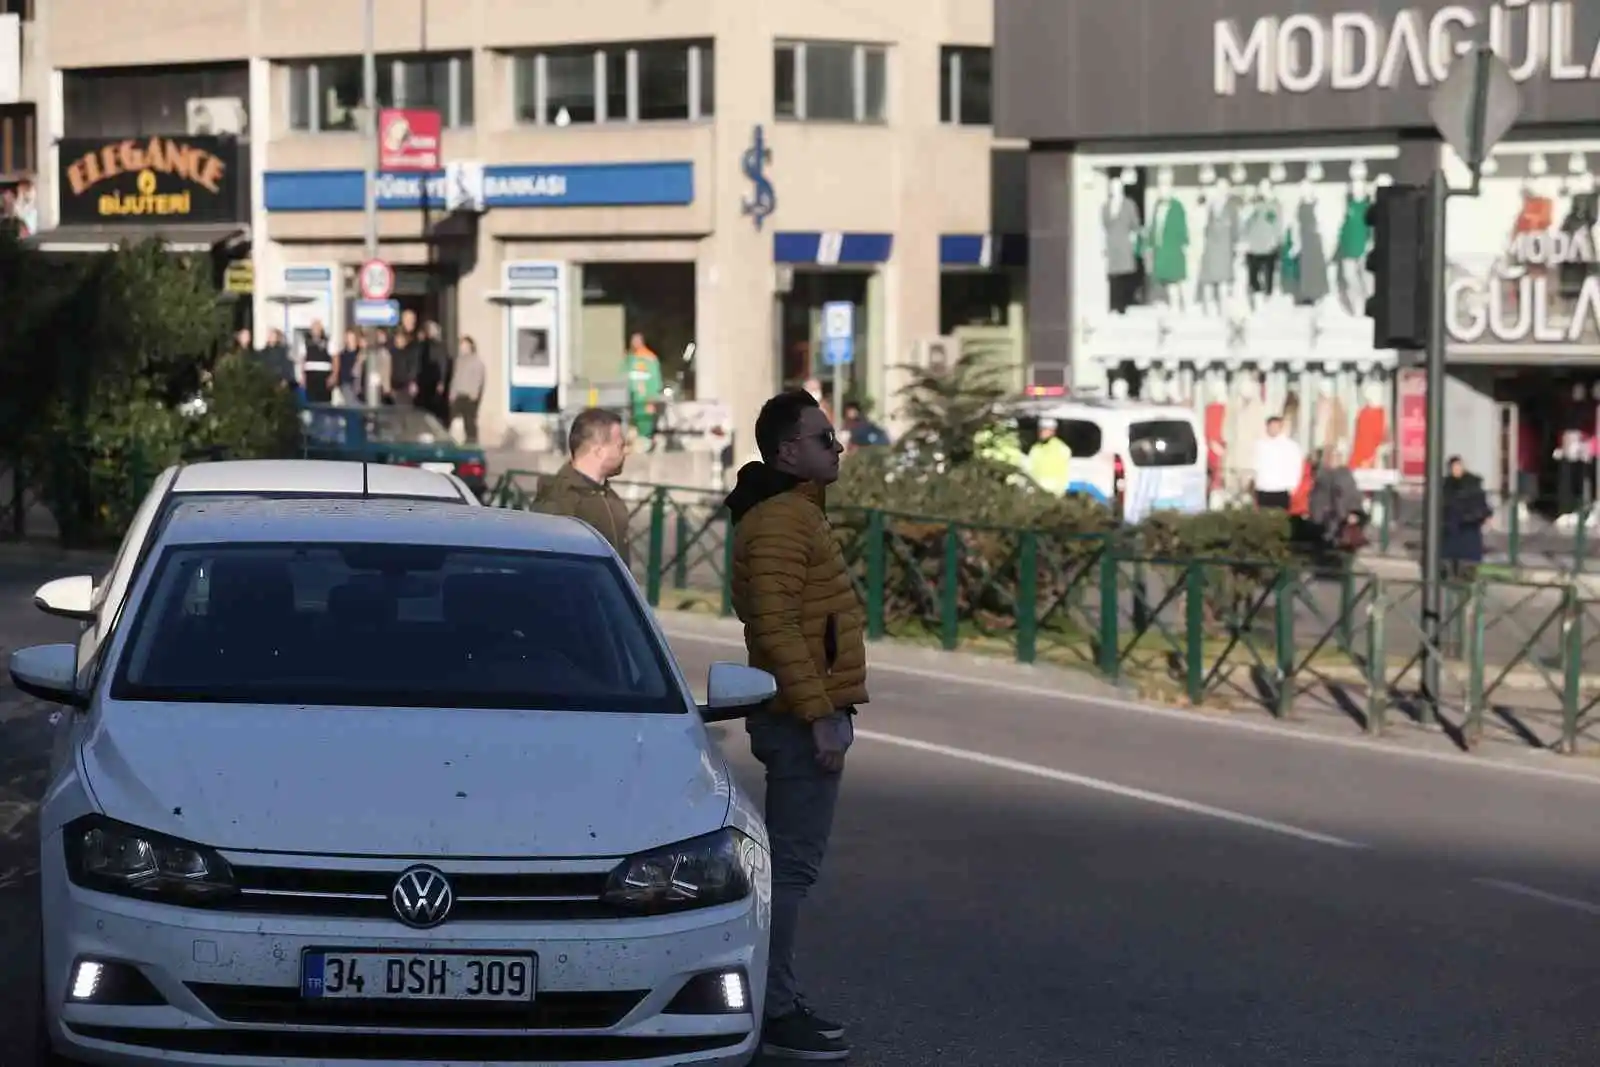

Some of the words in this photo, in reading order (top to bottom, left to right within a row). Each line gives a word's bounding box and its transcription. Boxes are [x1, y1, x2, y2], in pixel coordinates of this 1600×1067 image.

[66, 136, 226, 195] ELEGANCE
[484, 174, 567, 198] BANKASI
[308, 978, 323, 989] TR
[325, 958, 365, 993] 34
[386, 958, 447, 995] DSH
[466, 960, 527, 997] 309
